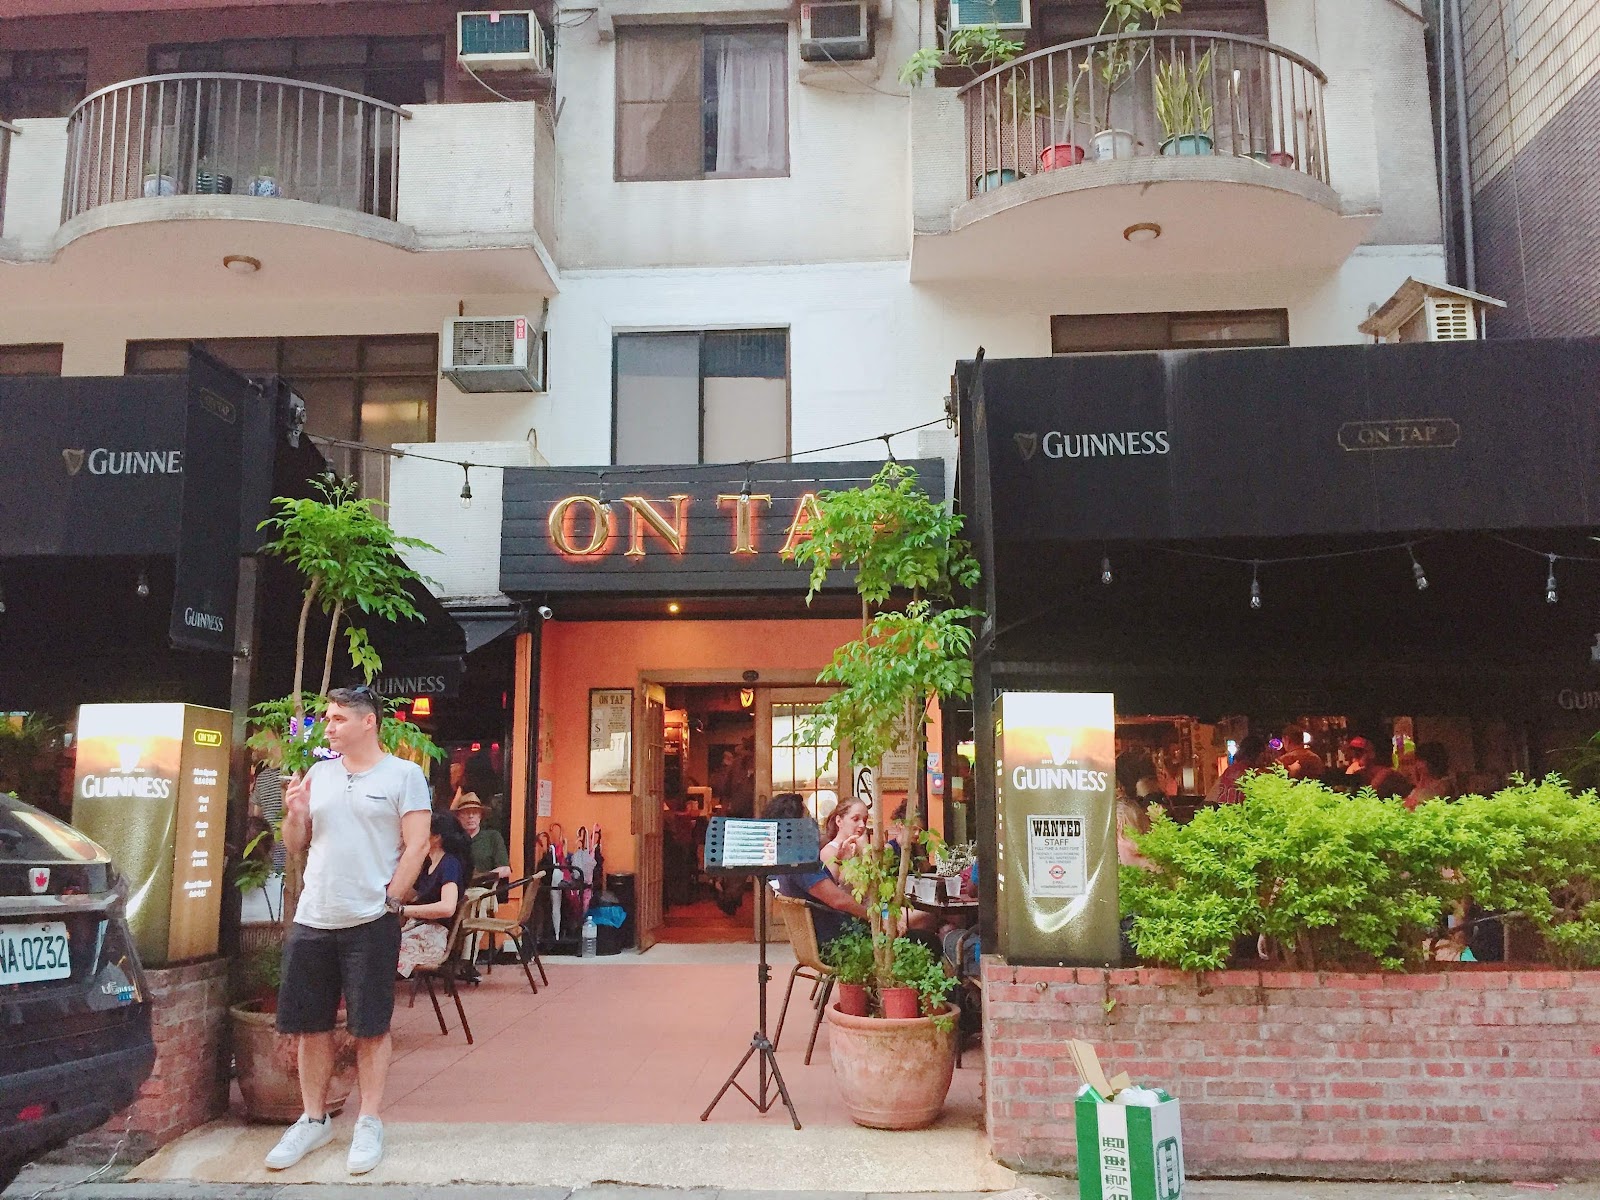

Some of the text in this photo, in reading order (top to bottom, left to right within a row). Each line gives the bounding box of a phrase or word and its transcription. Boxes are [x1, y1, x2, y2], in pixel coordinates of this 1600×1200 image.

[1042, 431, 1170, 459] GUINNESS
[1395, 425, 1437, 442] TAP
[88, 447, 183, 476] GUINNE
[548, 493, 862, 557] ON TA
[184, 606, 224, 633] GUINNESS
[372, 675, 446, 695] UINNESS
[598, 694, 625, 705] ON TAP
[81, 774, 171, 799] GUINNESS
[1012, 766, 1107, 792] GUINNESS
[1032, 820, 1081, 837] WANTED
[1044, 838, 1069, 847] STAFF
